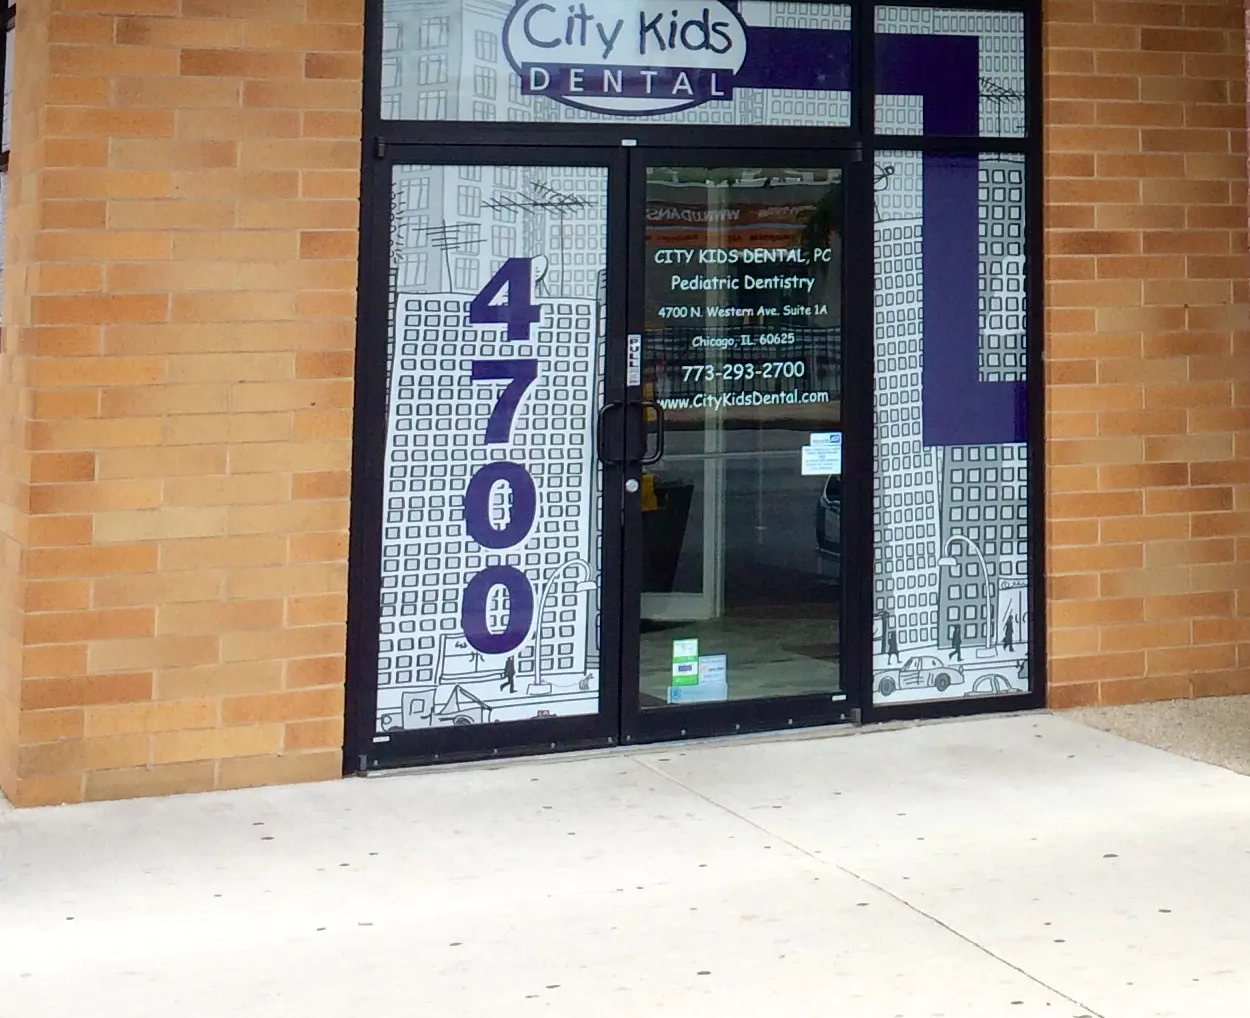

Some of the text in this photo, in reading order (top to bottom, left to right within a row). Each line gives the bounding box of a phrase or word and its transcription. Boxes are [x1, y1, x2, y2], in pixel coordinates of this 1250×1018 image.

[523, 2, 733, 60] City Kids
[529, 66, 725, 97] DENTAL
[654, 247, 832, 265] CITY KIDS DENTAL, PC
[671, 274, 816, 293] Pediatric Dentistry
[657, 306, 688, 319] 4700
[706, 305, 754, 318] Western
[756, 305, 781, 317] Ave.
[783, 304, 812, 316] Suite
[814, 304, 828, 316] 1A
[691, 335, 739, 350] Chicago,
[759, 332, 796, 346] 60625
[629, 338, 640, 368] PULL
[681, 360, 806, 383] 773-293-2700
[656, 389, 830, 411] www.CityKidsDental.com
[461, 256, 542, 655] 4700
